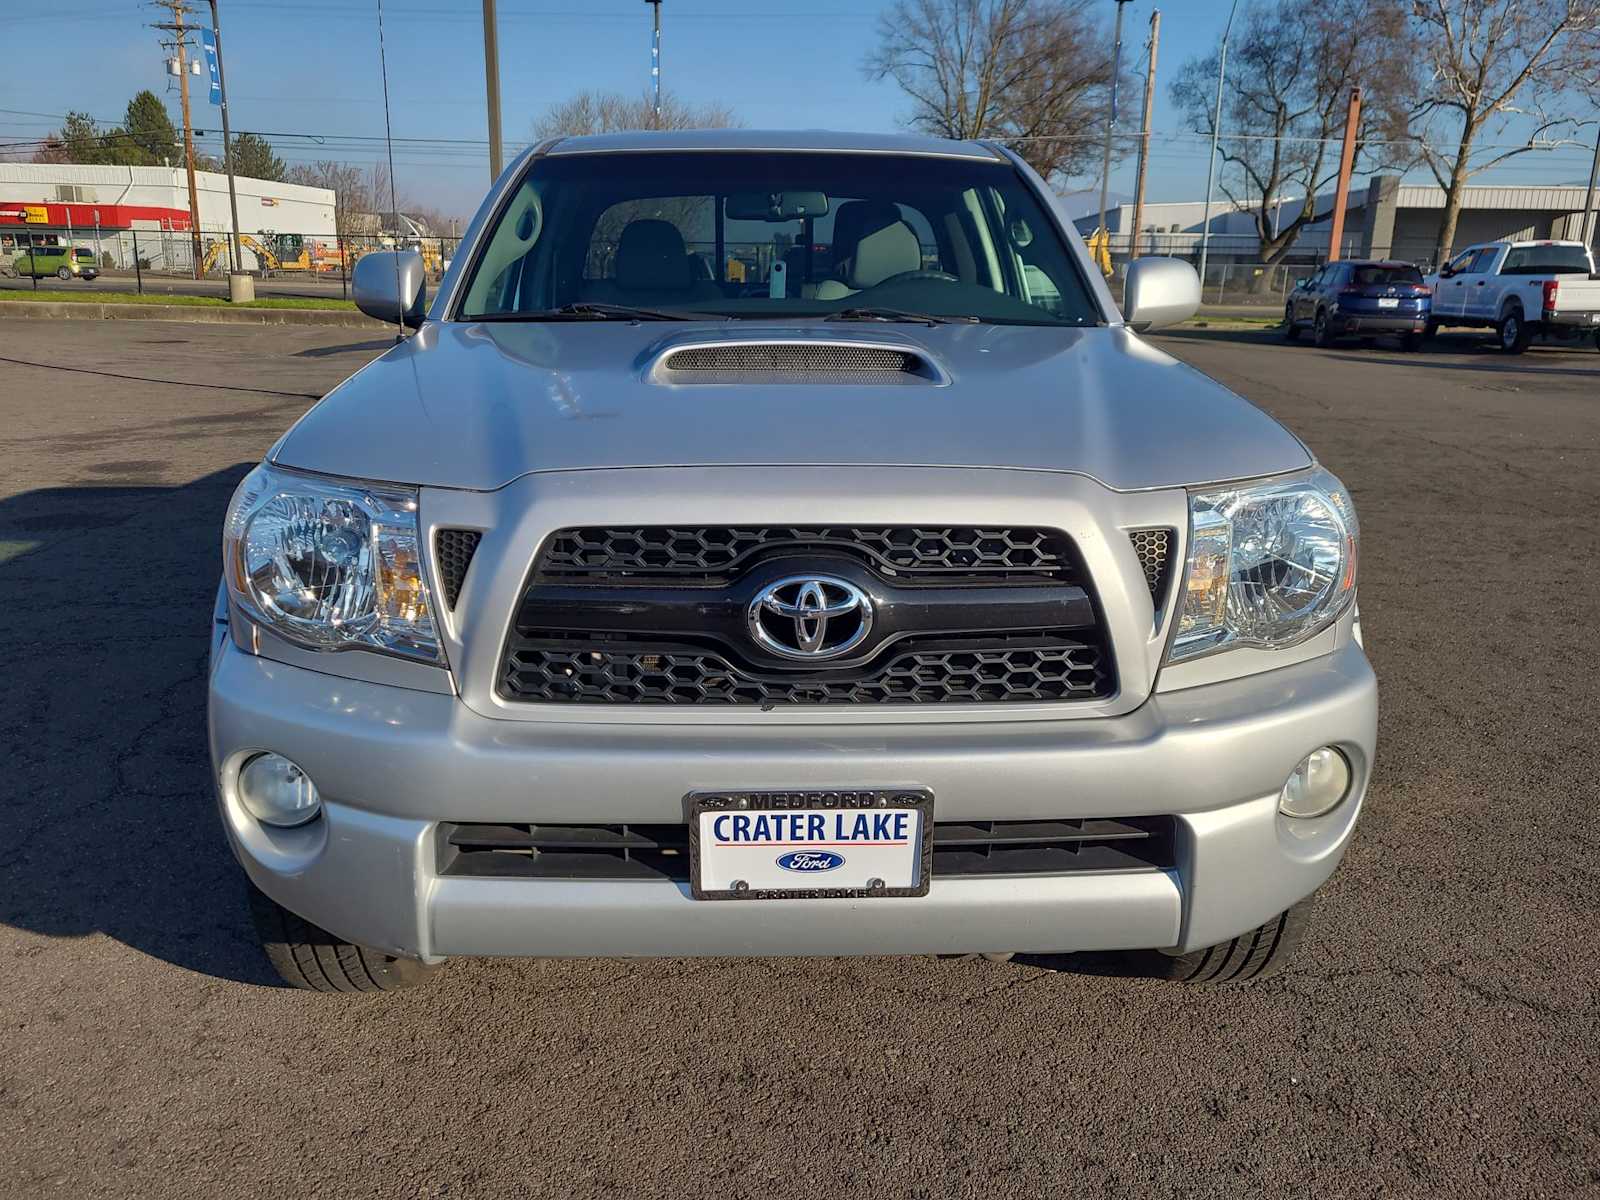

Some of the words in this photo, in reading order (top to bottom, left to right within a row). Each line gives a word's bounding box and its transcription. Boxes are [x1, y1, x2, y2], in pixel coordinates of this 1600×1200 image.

[750, 792, 876, 809] MEDFORD
[713, 814, 826, 842] CRATER
[835, 813, 909, 841] LAKE
[789, 852, 832, 870] Ford
[756, 888, 818, 900] CRATER
[824, 887, 869, 899] LAKE
